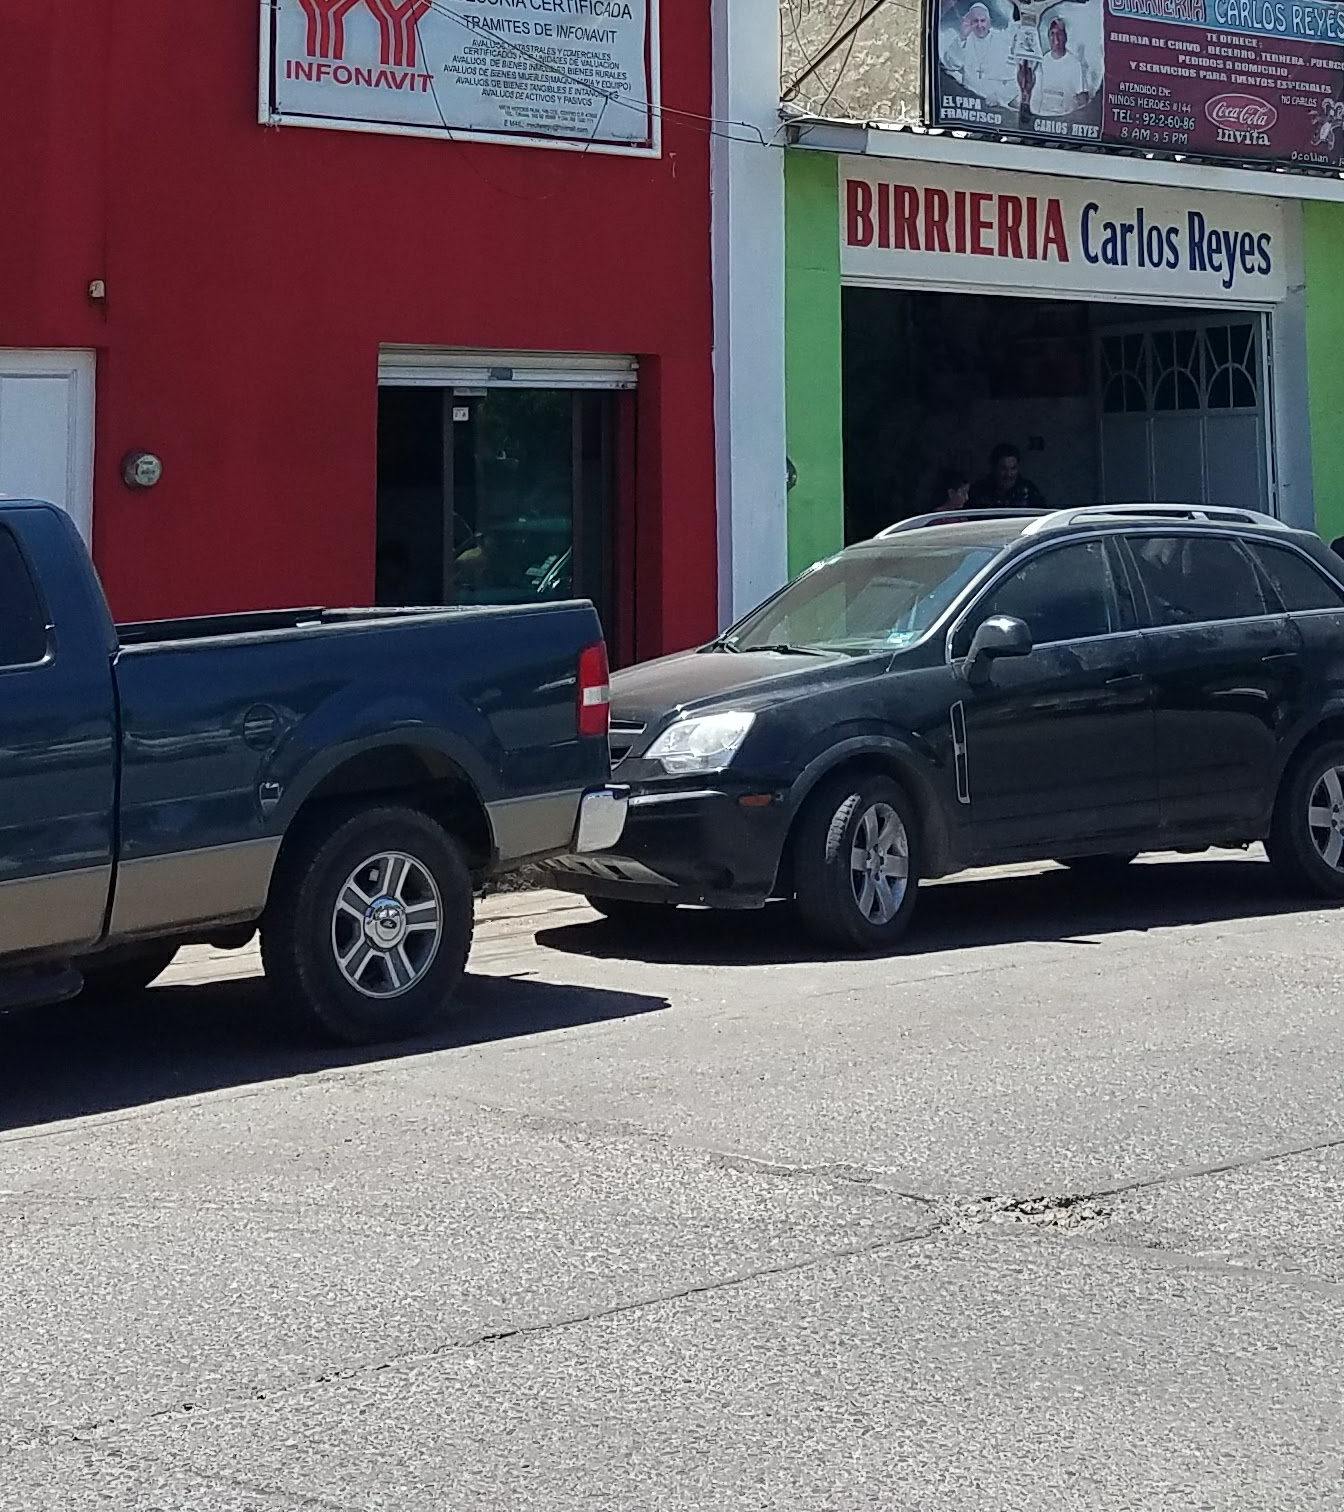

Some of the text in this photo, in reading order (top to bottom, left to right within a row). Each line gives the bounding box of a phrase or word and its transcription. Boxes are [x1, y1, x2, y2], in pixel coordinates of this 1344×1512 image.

[463, 14, 618, 45] TRAMITES DE INFONAVIT
[1110, 31, 1150, 46] BIRRIA
[1152, 37, 1166, 48] DE
[463, 46, 517, 61] CERTIFICADOS
[569, 57, 579, 67] DE
[580, 59, 620, 70] VALUACION
[563, 48, 612, 61] COMERCIALES
[1179, 54, 1224, 70] PEDIDOS
[285, 59, 435, 93] INFONAVIT
[443, 63, 477, 76] AVALUOS
[478, 67, 489, 77] DE
[490, 68, 517, 80] BIENES
[452, 55, 487, 66] AVALUOS
[490, 58, 500, 68] DE
[501, 60, 528, 71] BIENES
[567, 67, 594, 77] BIENES
[595, 69, 628, 81] RURALES
[1130, 61, 1332, 94] Y SERVICIOS PARA EVENTOS ESPECIALES
[455, 76, 490, 88] AVALUOS
[490, 79, 502, 89] DE
[503, 80, 528, 91] BIENES
[568, 87, 573, 95] E
[1119, 82, 1156, 96] ATENDIDO
[481, 87, 593, 107] AVALUOS DE ACTIVOS Y PASIVOS
[942, 95, 982, 110] EL PAPA
[1108, 92, 1136, 107] NIÑOS
[1137, 97, 1171, 111] HEROES
[940, 107, 1002, 125] FRANCISCO
[1213, 101, 1269, 126] Coca-Cola
[1033, 118, 1100, 138] CARLOS REYES
[1120, 127, 1128, 138] 8
[1131, 128, 1150, 141] AM
[1162, 131, 1169, 143] 5
[1172, 132, 1189, 145] PM
[1216, 126, 1271, 146] invita
[845, 178, 1273, 289] BIRRIERIA Carlos Reyes
